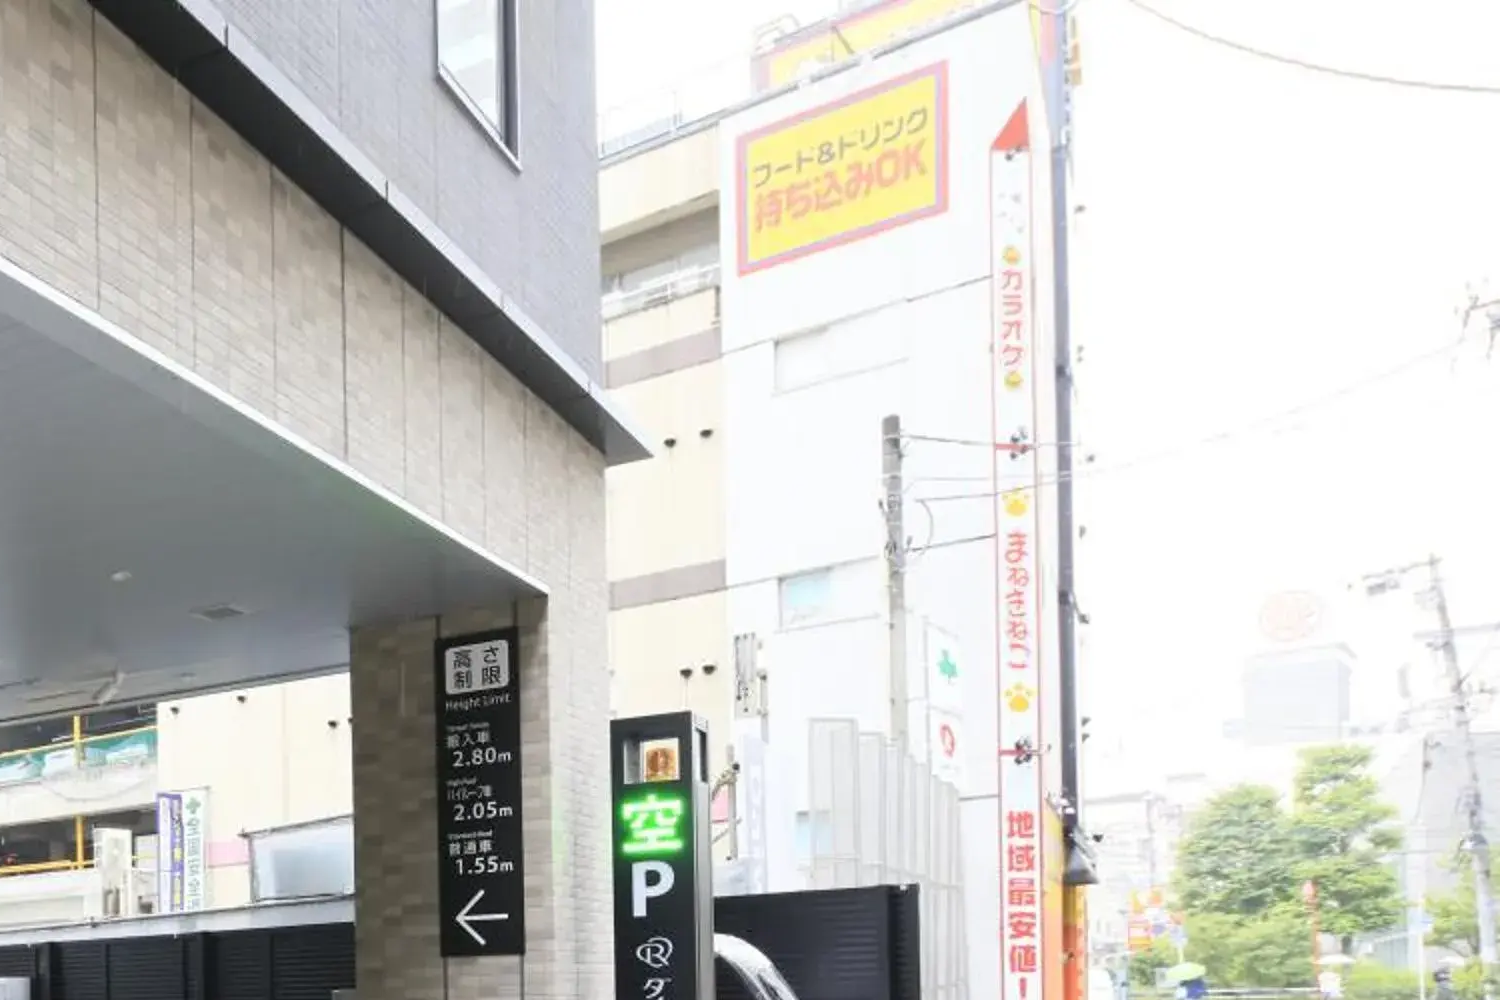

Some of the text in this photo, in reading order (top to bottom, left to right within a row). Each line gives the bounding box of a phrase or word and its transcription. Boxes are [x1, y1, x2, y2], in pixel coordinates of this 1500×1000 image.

[754, 137, 928, 234] 持ち込みOK
[1001, 269, 1024, 367] カラオケ
[1004, 531, 1031, 670] まねきねこ
[453, 665, 502, 690] 制限
[452, 747, 512, 768] 2.80m
[453, 801, 514, 822] 2.05m
[621, 793, 684, 855] 空
[455, 855, 515, 876] 1.55m
[631, 860, 676, 918] P
